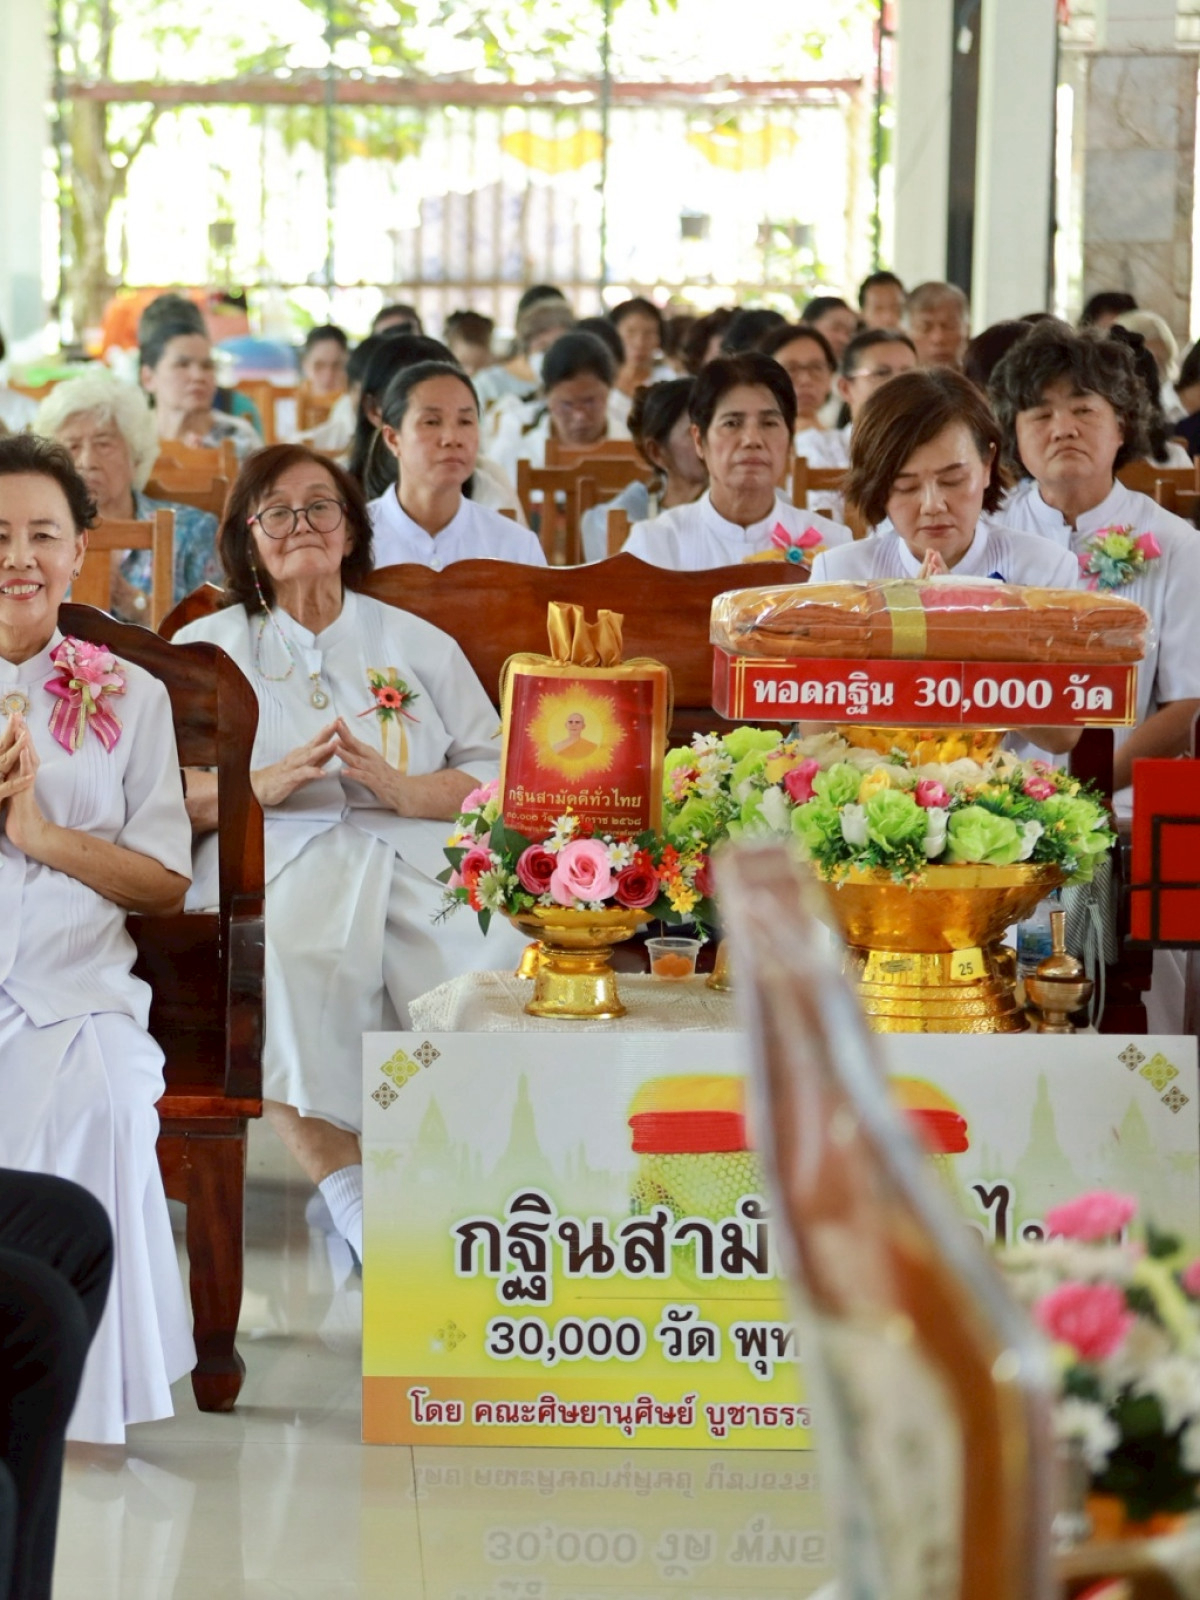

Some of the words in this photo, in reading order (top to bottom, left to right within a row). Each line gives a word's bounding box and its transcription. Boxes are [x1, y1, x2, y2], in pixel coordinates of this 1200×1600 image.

[752, 671, 894, 715] ทอดกฐิน
[914, 677, 1052, 713] 30,000
[1062, 673, 1113, 711] วัด
[508, 785, 642, 808] กฐินสามัคคีทั่วไทย
[958, 963, 974, 976] 25
[455, 1193, 771, 1300] กฐินสามั
[490, 1322, 641, 1361] 30,000
[659, 1310, 715, 1357] วัด
[735, 1326, 800, 1375] พุท
[410, 1389, 461, 1422] โดย
[475, 1395, 696, 1435] คณะศิษยานุศิษย์
[706, 1405, 812, 1436] บูชาธรร
